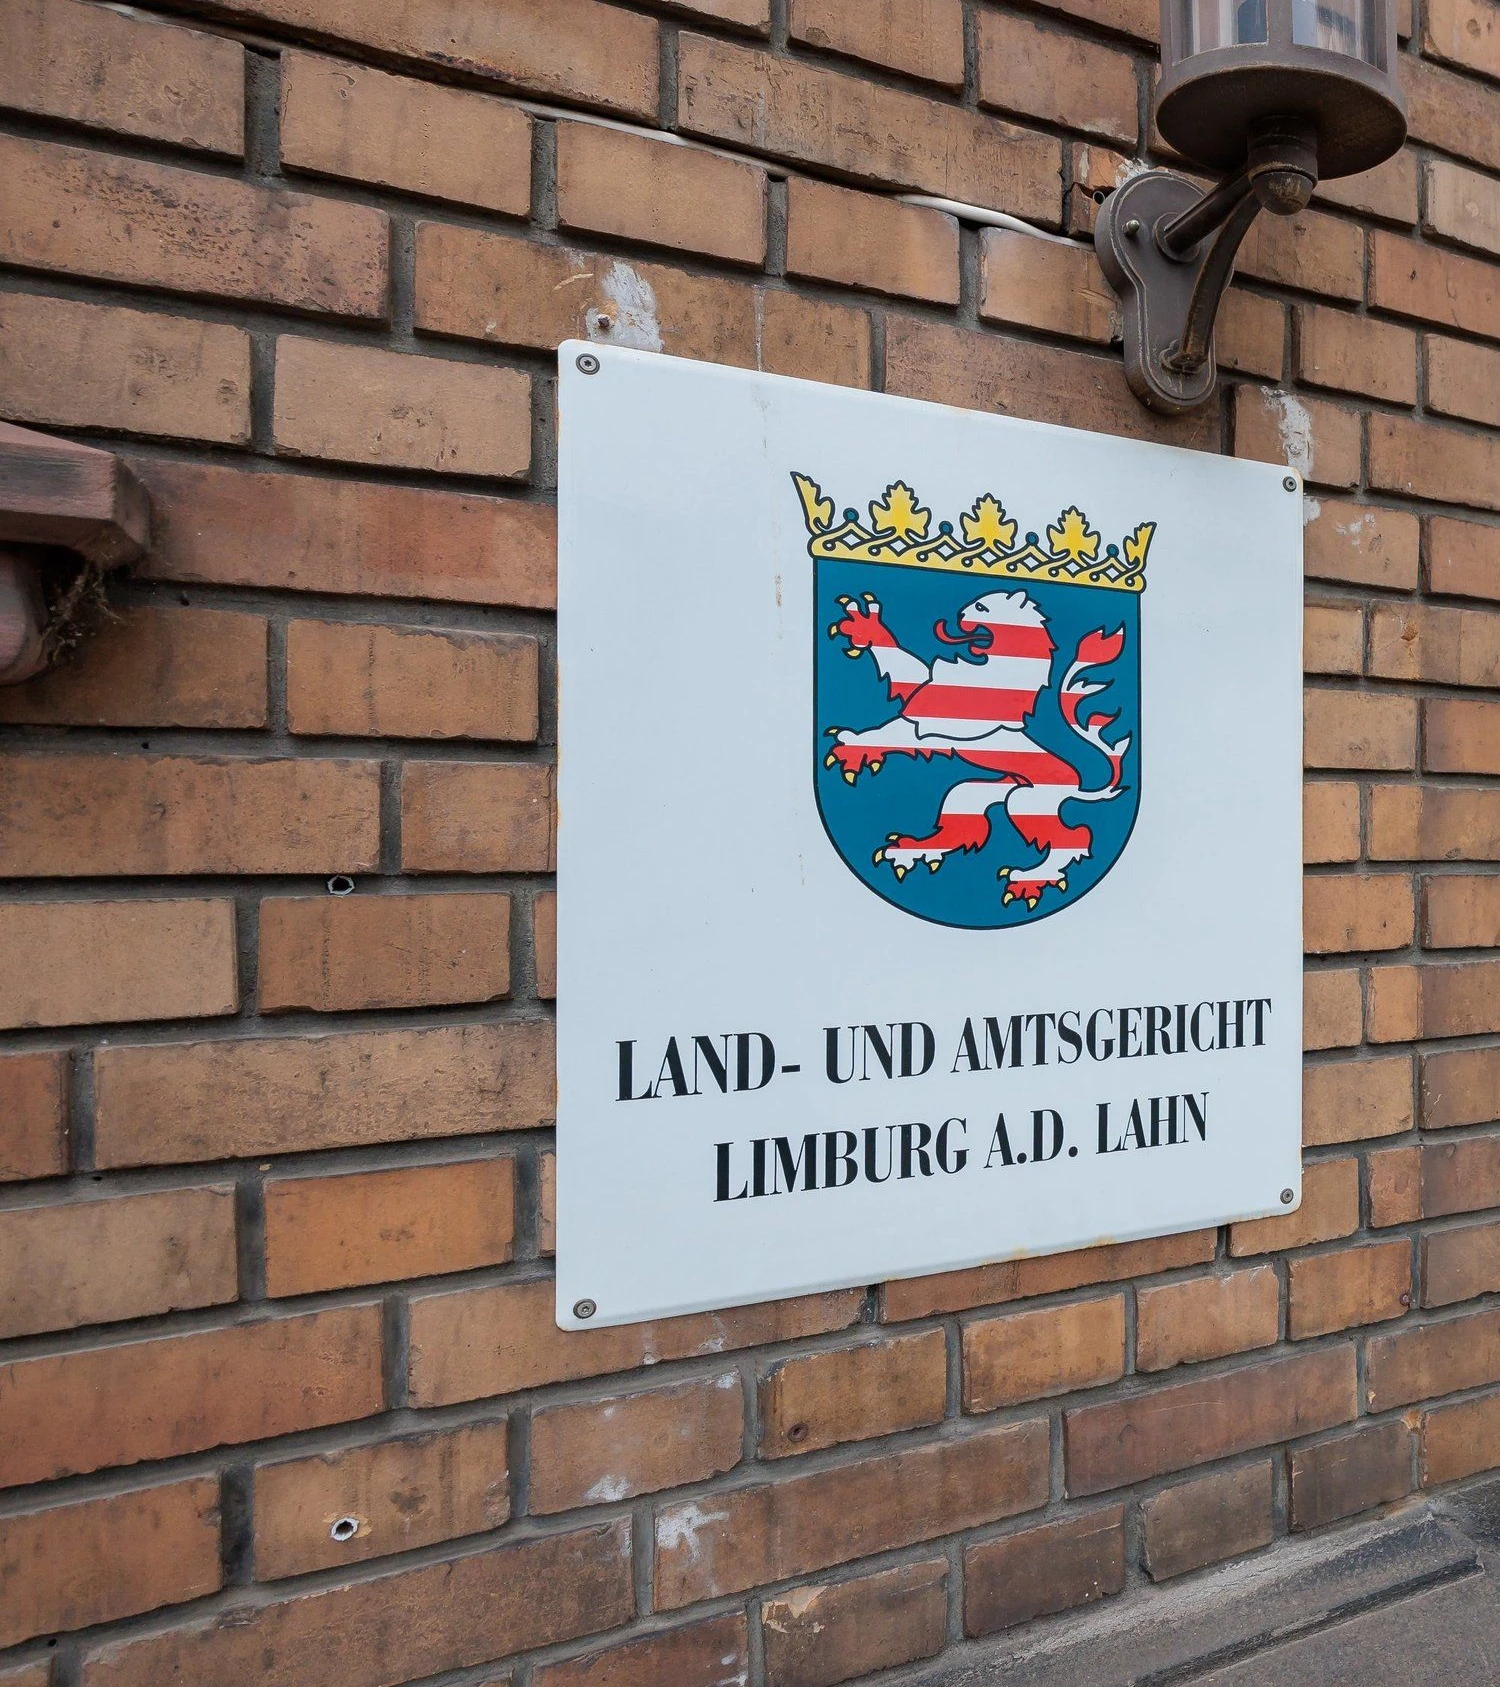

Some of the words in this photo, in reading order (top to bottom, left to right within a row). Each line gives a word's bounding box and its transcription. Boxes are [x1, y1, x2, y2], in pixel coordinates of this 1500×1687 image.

[615, 1032, 801, 1102] LAND-
[822, 1021, 936, 1084] UND
[950, 998, 1272, 1074] AMTSGERICHT
[713, 1117, 970, 1203] LIMBURG
[983, 1109, 1078, 1169] A.D.
[1095, 1092, 1210, 1155] LAHN
